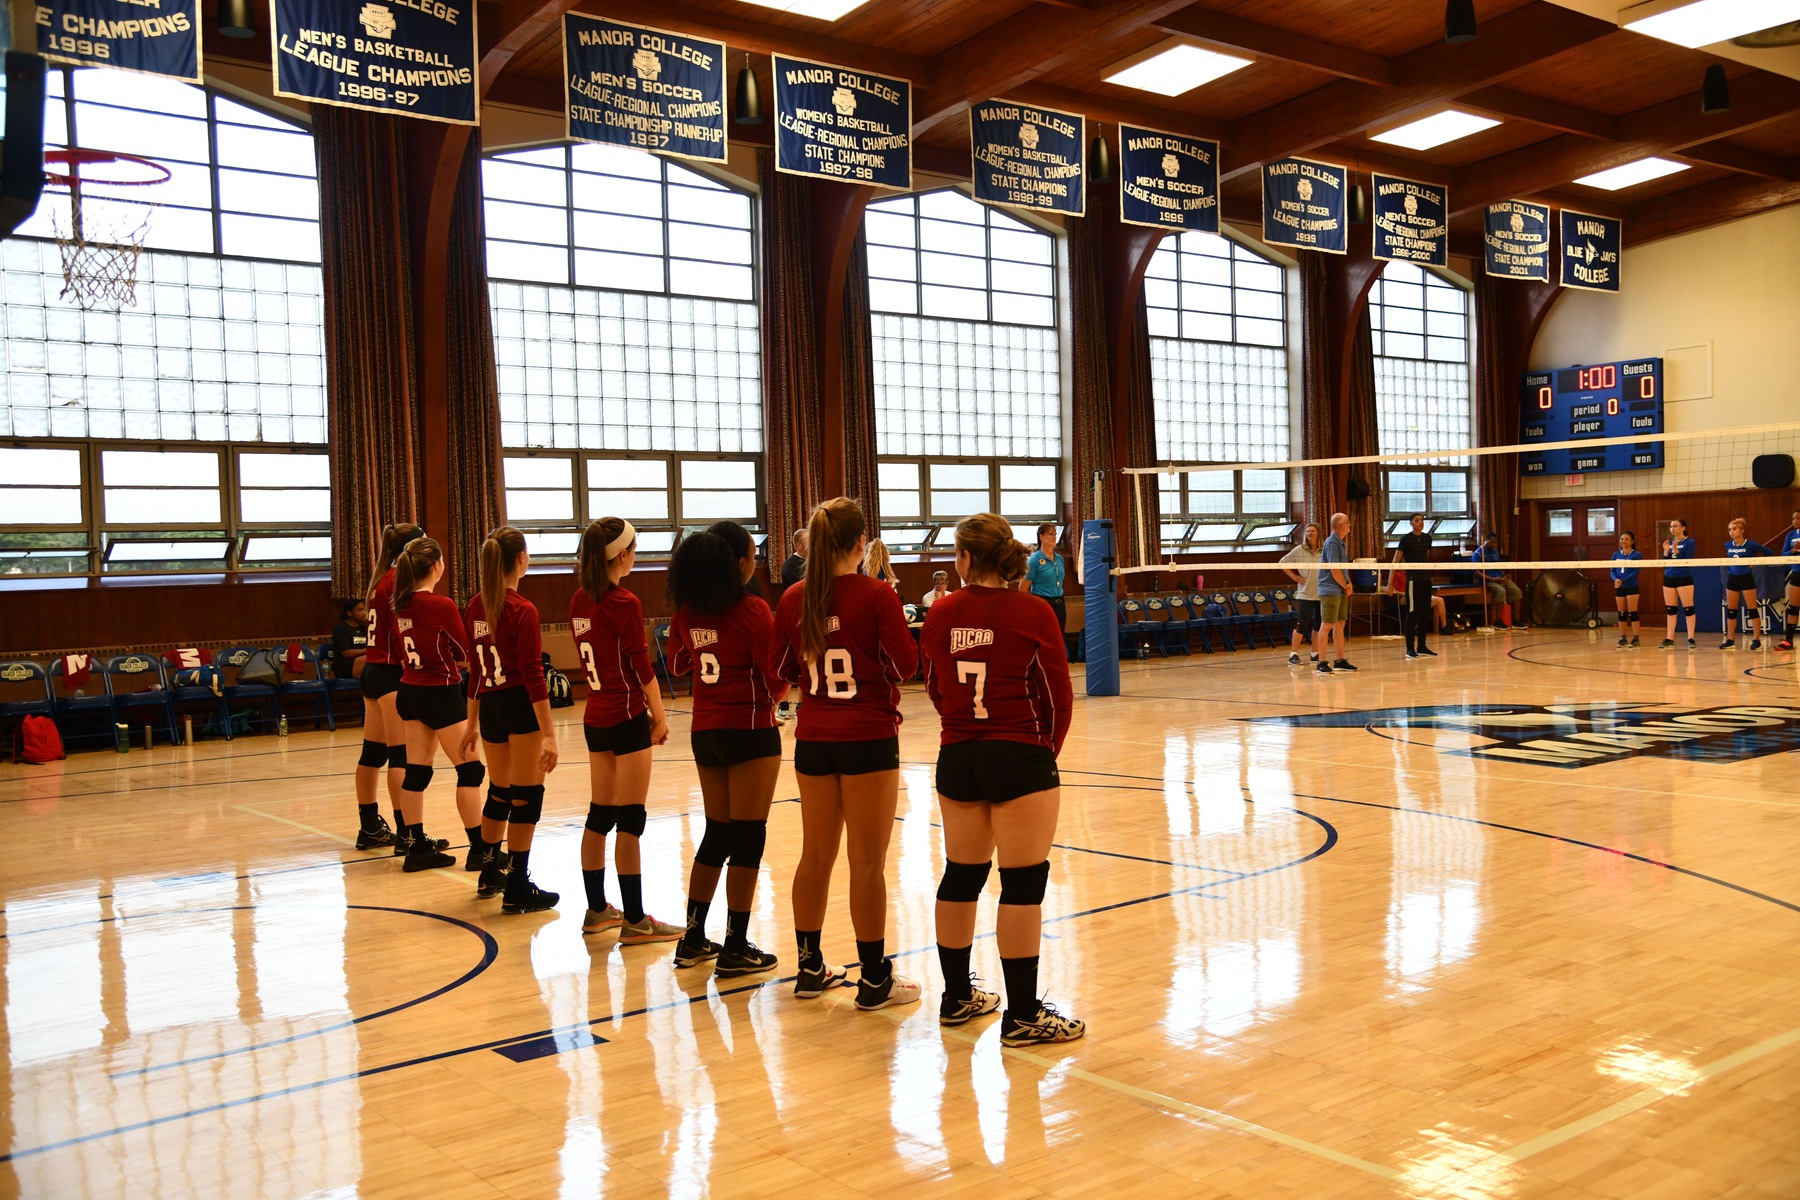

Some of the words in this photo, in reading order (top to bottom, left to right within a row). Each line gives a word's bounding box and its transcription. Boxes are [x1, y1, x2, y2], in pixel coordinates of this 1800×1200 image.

[62, 11, 191, 39] CHAMPIONS
[48, 34, 110, 59] 1996
[299, 28, 347, 49] MEN'S
[353, 38, 454, 68] BASKETBALL
[578, 30, 635, 46] MANOR
[640, 33, 713, 71] COLLEGE
[279, 33, 360, 77] LEAGUE
[367, 64, 472, 87] CHAMPIONS
[338, 81, 420, 106] 1996-97
[570, 74, 664, 117] LEAGUE-REGIONAL
[667, 100, 722, 119] CHAMPIONS
[590, 71, 637, 90] MEN'S
[642, 80, 703, 102] SOCCER
[785, 69, 834, 85] MANOR
[838, 72, 901, 106] COLLEGE
[570, 105, 602, 124] STATE
[604, 110, 673, 134] CHAMPIONSHIP
[674, 123, 723, 143] RUNNER-UP
[779, 111, 859, 150] LEAGUE-REGIONAL
[861, 133, 908, 151] CHAMPIONS
[795, 107, 834, 125] WOMEN'S
[837, 116, 893, 136] BASKETBALL
[980, 108, 1020, 122] MANOR
[1023, 109, 1076, 139] COLLEGE
[630, 131, 670, 147] 1997
[804, 144, 834, 161] STATE
[838, 149, 885, 169] CHAMPIONS
[975, 145, 1042, 179] LEAGUE-REGIONAL
[1043, 163, 1081, 179] CHAMPIONS
[987, 142, 1020, 158] WOMEN'S
[1022, 148, 1070, 166] BASKETBALL
[1128, 137, 1163, 151] MANOR
[1165, 139, 1211, 165] COLLEGE
[819, 161, 873, 180] 1997-98
[1269, 163, 1299, 176] MANOR
[1300, 164, 1340, 190] COLLEGE
[991, 173, 1019, 189] STATE
[1021, 178, 1067, 197] CHAMPIONS
[1124, 180, 1182, 210] LEAGUE-REGIONAL
[1183, 195, 1216, 210] CHAMPIONS
[1136, 175, 1165, 189] MEN'S
[1167, 181, 1204, 195] SOCCER
[1378, 183, 1405, 196] MANOR
[1406, 184, 1441, 206] COLLEGE
[1007, 190, 1053, 206] 1998-99
[1280, 200, 1305, 213] WOMEN'S
[1307, 204, 1330, 217] SOCCER
[1159, 211, 1184, 223] 1999
[1272, 208, 1300, 229] LEAGUE
[1301, 218, 1338, 231] CHAMPIONS
[1384, 211, 1407, 223] MEN'S
[1407, 215, 1437, 228] SOCCER
[1489, 202, 1512, 214] MANOR
[1512, 203, 1545, 224] COLLEGE
[1295, 232, 1317, 243] 1999
[1420, 225, 1446, 240] CHAMPIONS
[1494, 229, 1513, 240] MEN'S
[1514, 232, 1543, 242] SOCCER
[1576, 220, 1606, 240] MANOR
[1384, 234, 1405, 246] STATE
[1404, 238, 1437, 252] CHAMPIONS
[1566, 244, 1584, 258] BLUE
[1600, 250, 1617, 263] JAYS
[1494, 252, 1511, 265] STATE
[1509, 265, 1529, 275] 2001
[1573, 263, 1610, 284] COLLEGE
[1578, 365, 1616, 390] 1:00
[1623, 363, 1653, 375] Guests
[1526, 375, 1548, 386] Home
[1640, 375, 1655, 398] 0
[1539, 387, 1552, 409] 0
[1607, 398, 1618, 415] 0
[1573, 403, 1600, 418] period
[1525, 427, 1544, 437] fouls
[1573, 420, 1600, 434] player
[1632, 416, 1653, 428] fouls
[1527, 462, 1543, 471] won
[1577, 459, 1598, 470] game
[1634, 454, 1652, 463] won
[1567, 474, 1581, 485] EXIT
[367, 608, 377, 647] 2
[690, 628, 718, 649] NJCAA
[950, 627, 994, 654] NJCAA
[476, 644, 507, 688] 11
[580, 642, 602, 691] 3
[803, 648, 858, 699] 18
[956, 660, 989, 720] 7
